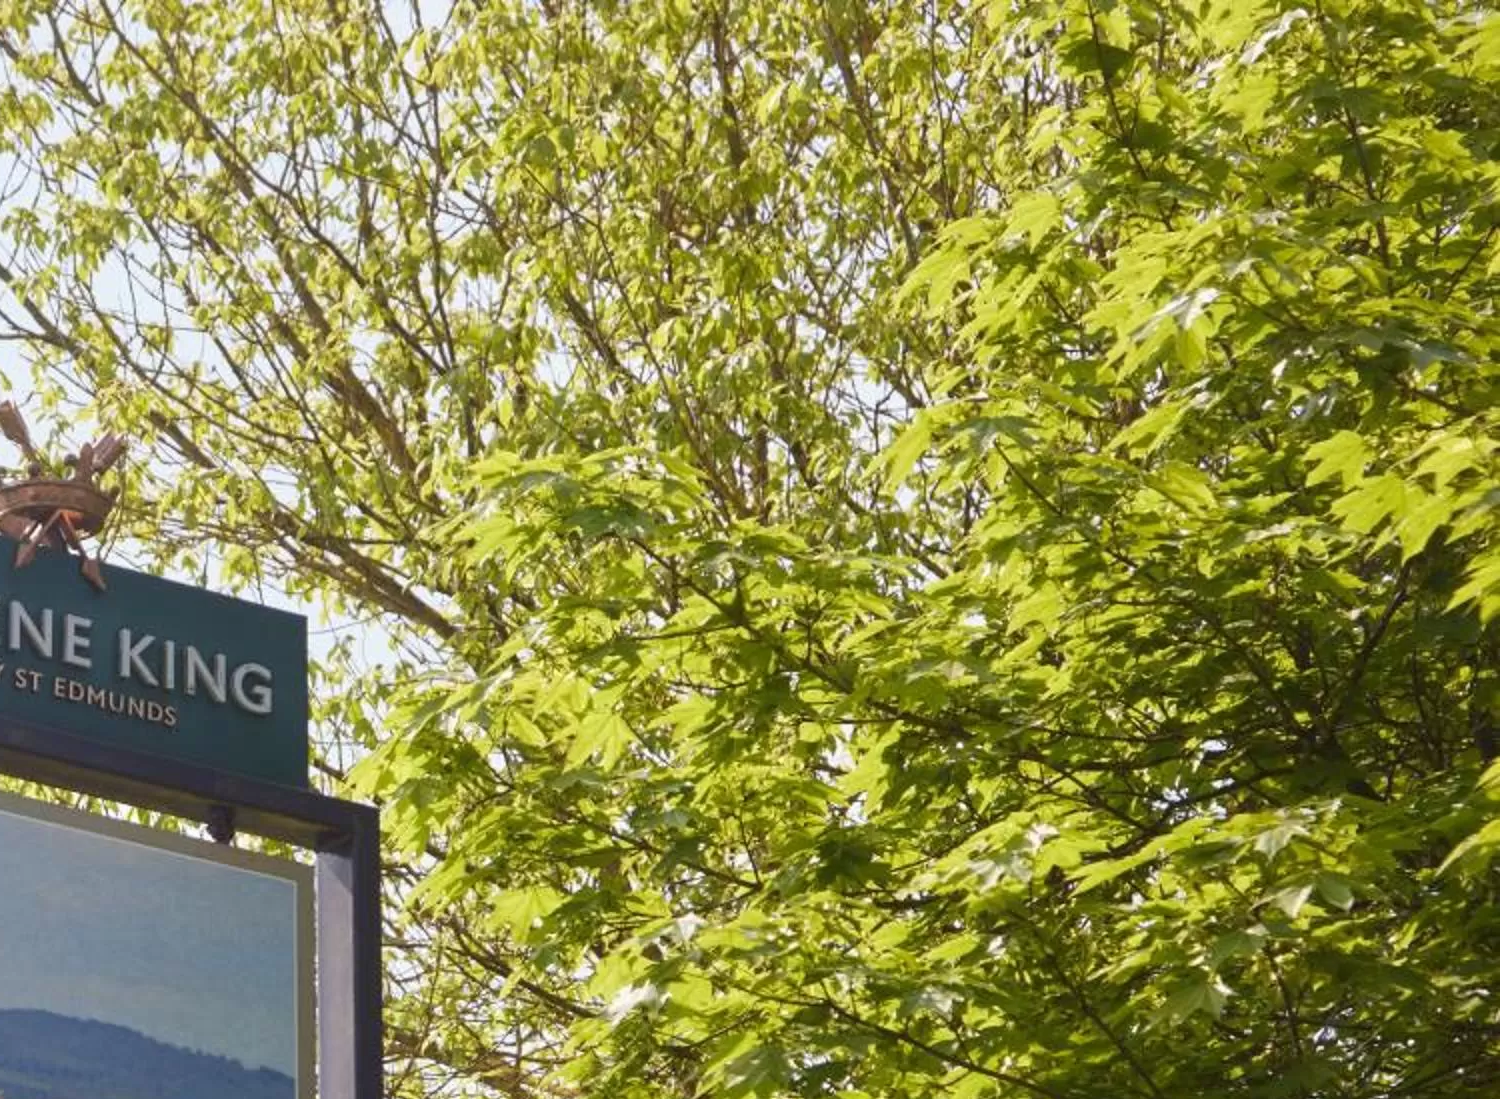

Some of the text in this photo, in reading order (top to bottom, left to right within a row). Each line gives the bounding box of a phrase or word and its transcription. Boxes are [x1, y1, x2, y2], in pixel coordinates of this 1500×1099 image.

[15, 669, 41, 692] ST
[54, 677, 177, 727] EDMUNDS
[119, 628, 273, 714] KING
